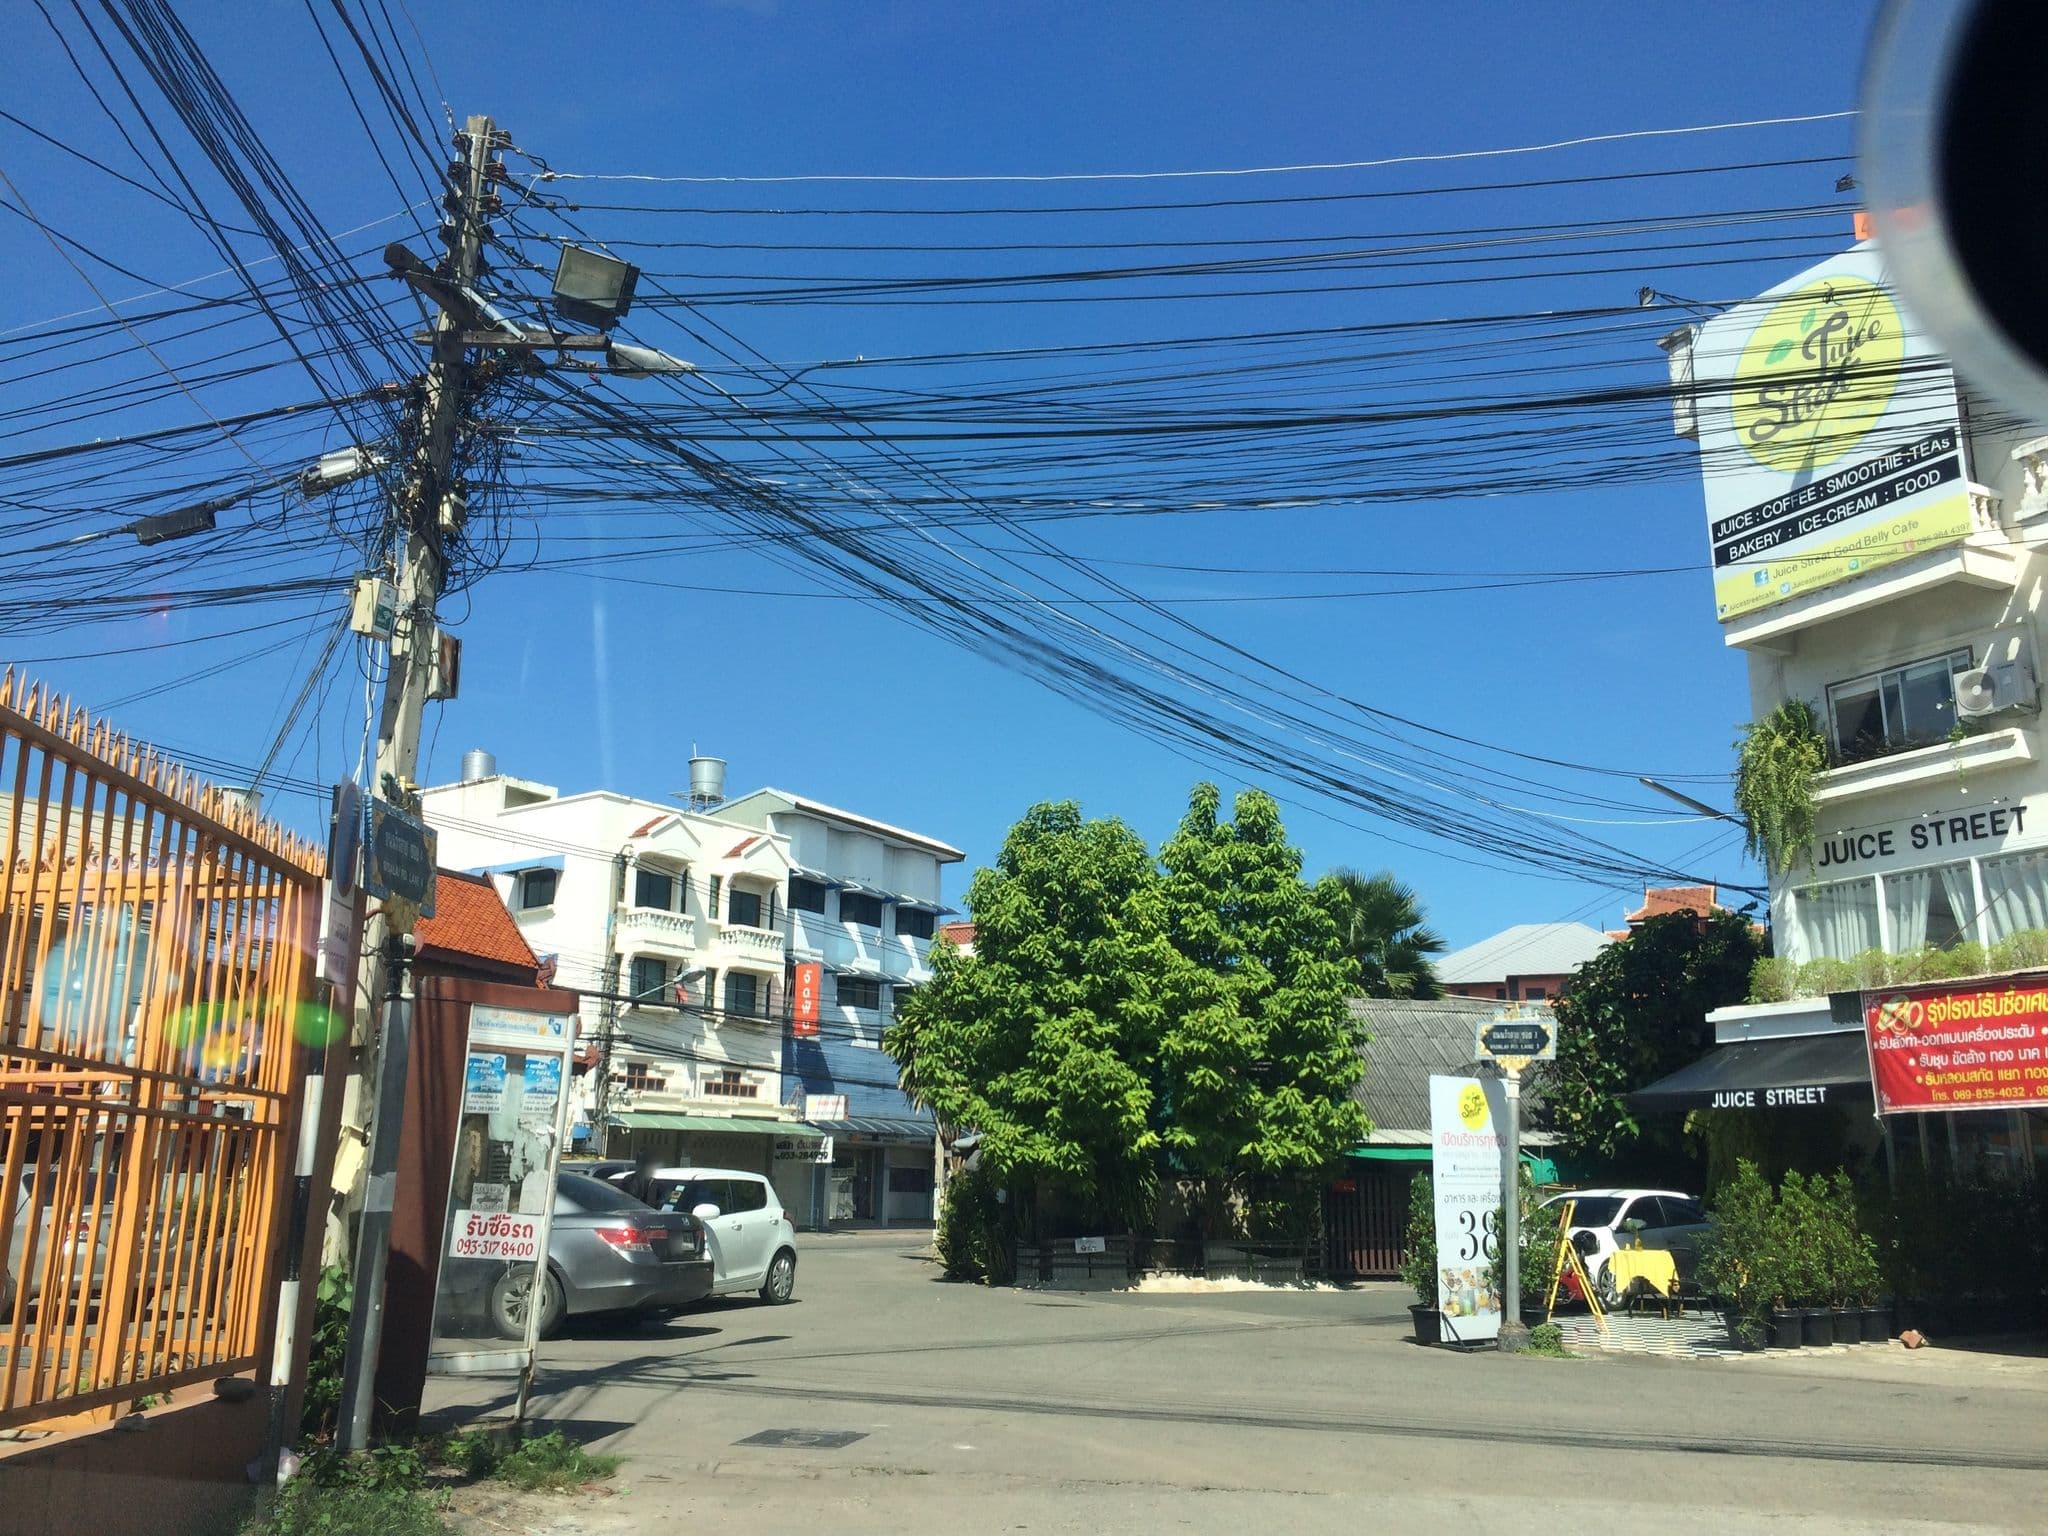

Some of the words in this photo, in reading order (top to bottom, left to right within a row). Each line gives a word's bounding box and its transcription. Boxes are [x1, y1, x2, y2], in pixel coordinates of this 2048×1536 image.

[1717, 515, 1754, 538] JUICE
[1762, 490, 1817, 520] COFFEE
[1826, 455, 1904, 494] SMOOTHIE
[1729, 529, 1782, 561] BAKERY
[1798, 492, 1878, 535] ICE-CREAM
[1895, 469, 1941, 498] FOOD
[1772, 562, 1798, 580] Juice
[1800, 553, 1833, 571] Street
[1833, 540, 1863, 561] Good
[1864, 527, 1891, 547] Belly
[1892, 519, 1919, 536] Cafe
[1819, 830, 1896, 867] JUICE
[1911, 806, 2028, 850] STREET
[1990, 1049, 2014, 1063] ทอง
[2018, 1047, 2040, 1060] นาค
[1711, 1092, 1755, 1108] JUICE
[1766, 1087, 1826, 1106] STREET
[466, 1213, 534, 1239] รับซื้อรถ
